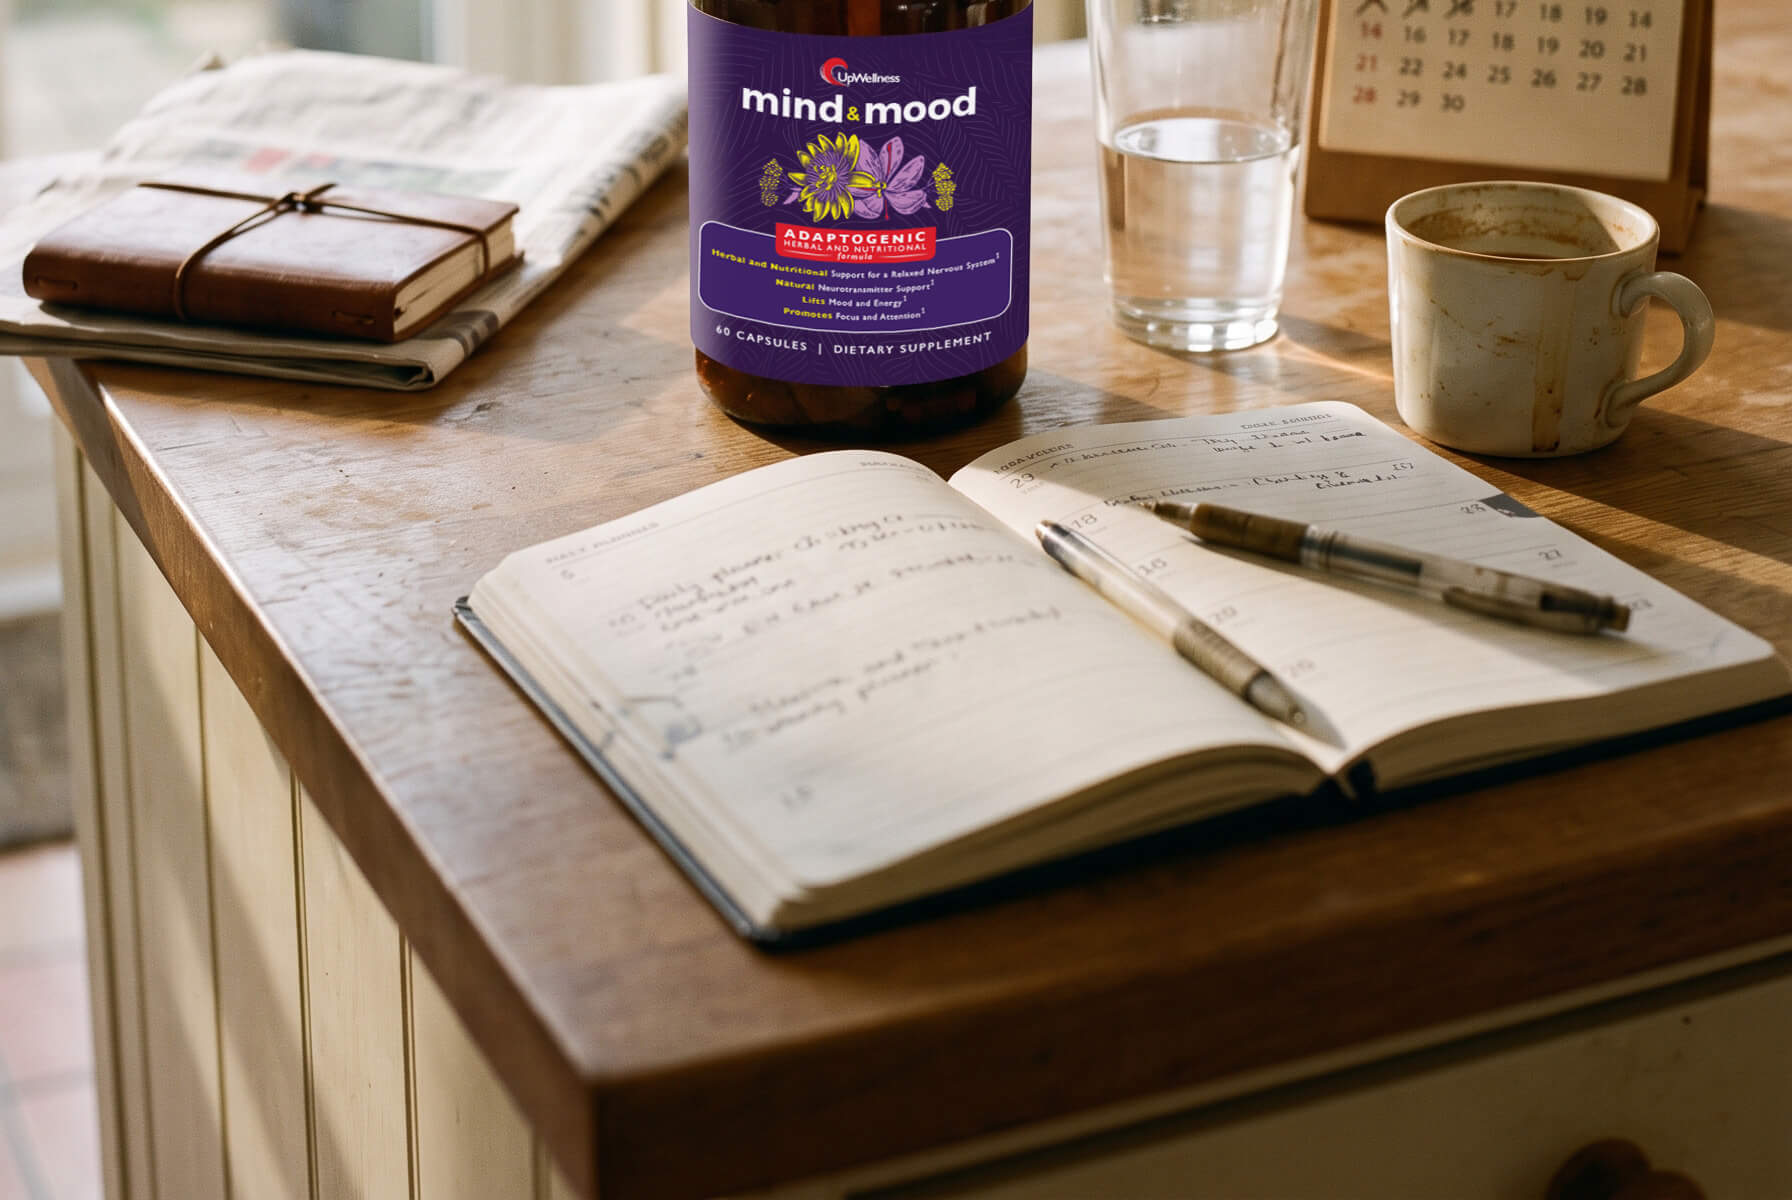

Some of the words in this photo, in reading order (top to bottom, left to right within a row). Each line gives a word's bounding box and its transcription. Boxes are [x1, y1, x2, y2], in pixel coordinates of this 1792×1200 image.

[1496, 0, 1517, 18] 17
[1541, 4, 1562, 23] 18
[1585, 6, 1608, 26] 19
[1629, 10, 1652, 29] 14
[1449, 28, 1470, 46] 17
[1538, 36, 1559, 54] 19
[1578, 39, 1605, 59] 20
[1623, 42, 1646, 63] 21
[838, 71, 900, 87] UpWellness
[1356, 53, 1377, 72] 21
[1442, 61, 1467, 80] 24
[1488, 65, 1511, 84] 25
[1531, 68, 1557, 88] 26
[1576, 71, 1602, 91] 27
[1621, 75, 1647, 96] 28
[742, 87, 843, 123] mind
[847, 106, 860, 121] &
[865, 86, 976, 124] mood
[1442, 93, 1465, 113] 30
[784, 229, 926, 244] ADAPTOGENIC
[784, 240, 822, 250] HERBAL
[854, 244, 926, 253] NUTRITIONAL
[712, 249, 745, 264] Herbal
[749, 259, 767, 268] and
[770, 263, 828, 277] Nutritional
[831, 270, 865, 279] Support
[868, 271, 880, 279] for
[891, 269, 924, 278] Relaxed
[928, 265, 963, 275] Nervous
[837, 252, 873, 261] formula
[776, 278, 814, 290] Natural
[818, 284, 893, 293] Neurotransmitter
[802, 296, 825, 305] Lifts
[828, 298, 853, 307] Mood
[784, 307, 832, 319] Promotes
[836, 312, 860, 321] Focus
[862, 313, 878, 321] and
[716, 325, 730, 336] 60
[736, 331, 808, 351] CAPSULES
[833, 344, 894, 355] DIETARY
[900, 331, 992, 354] SUPPLEMENT
